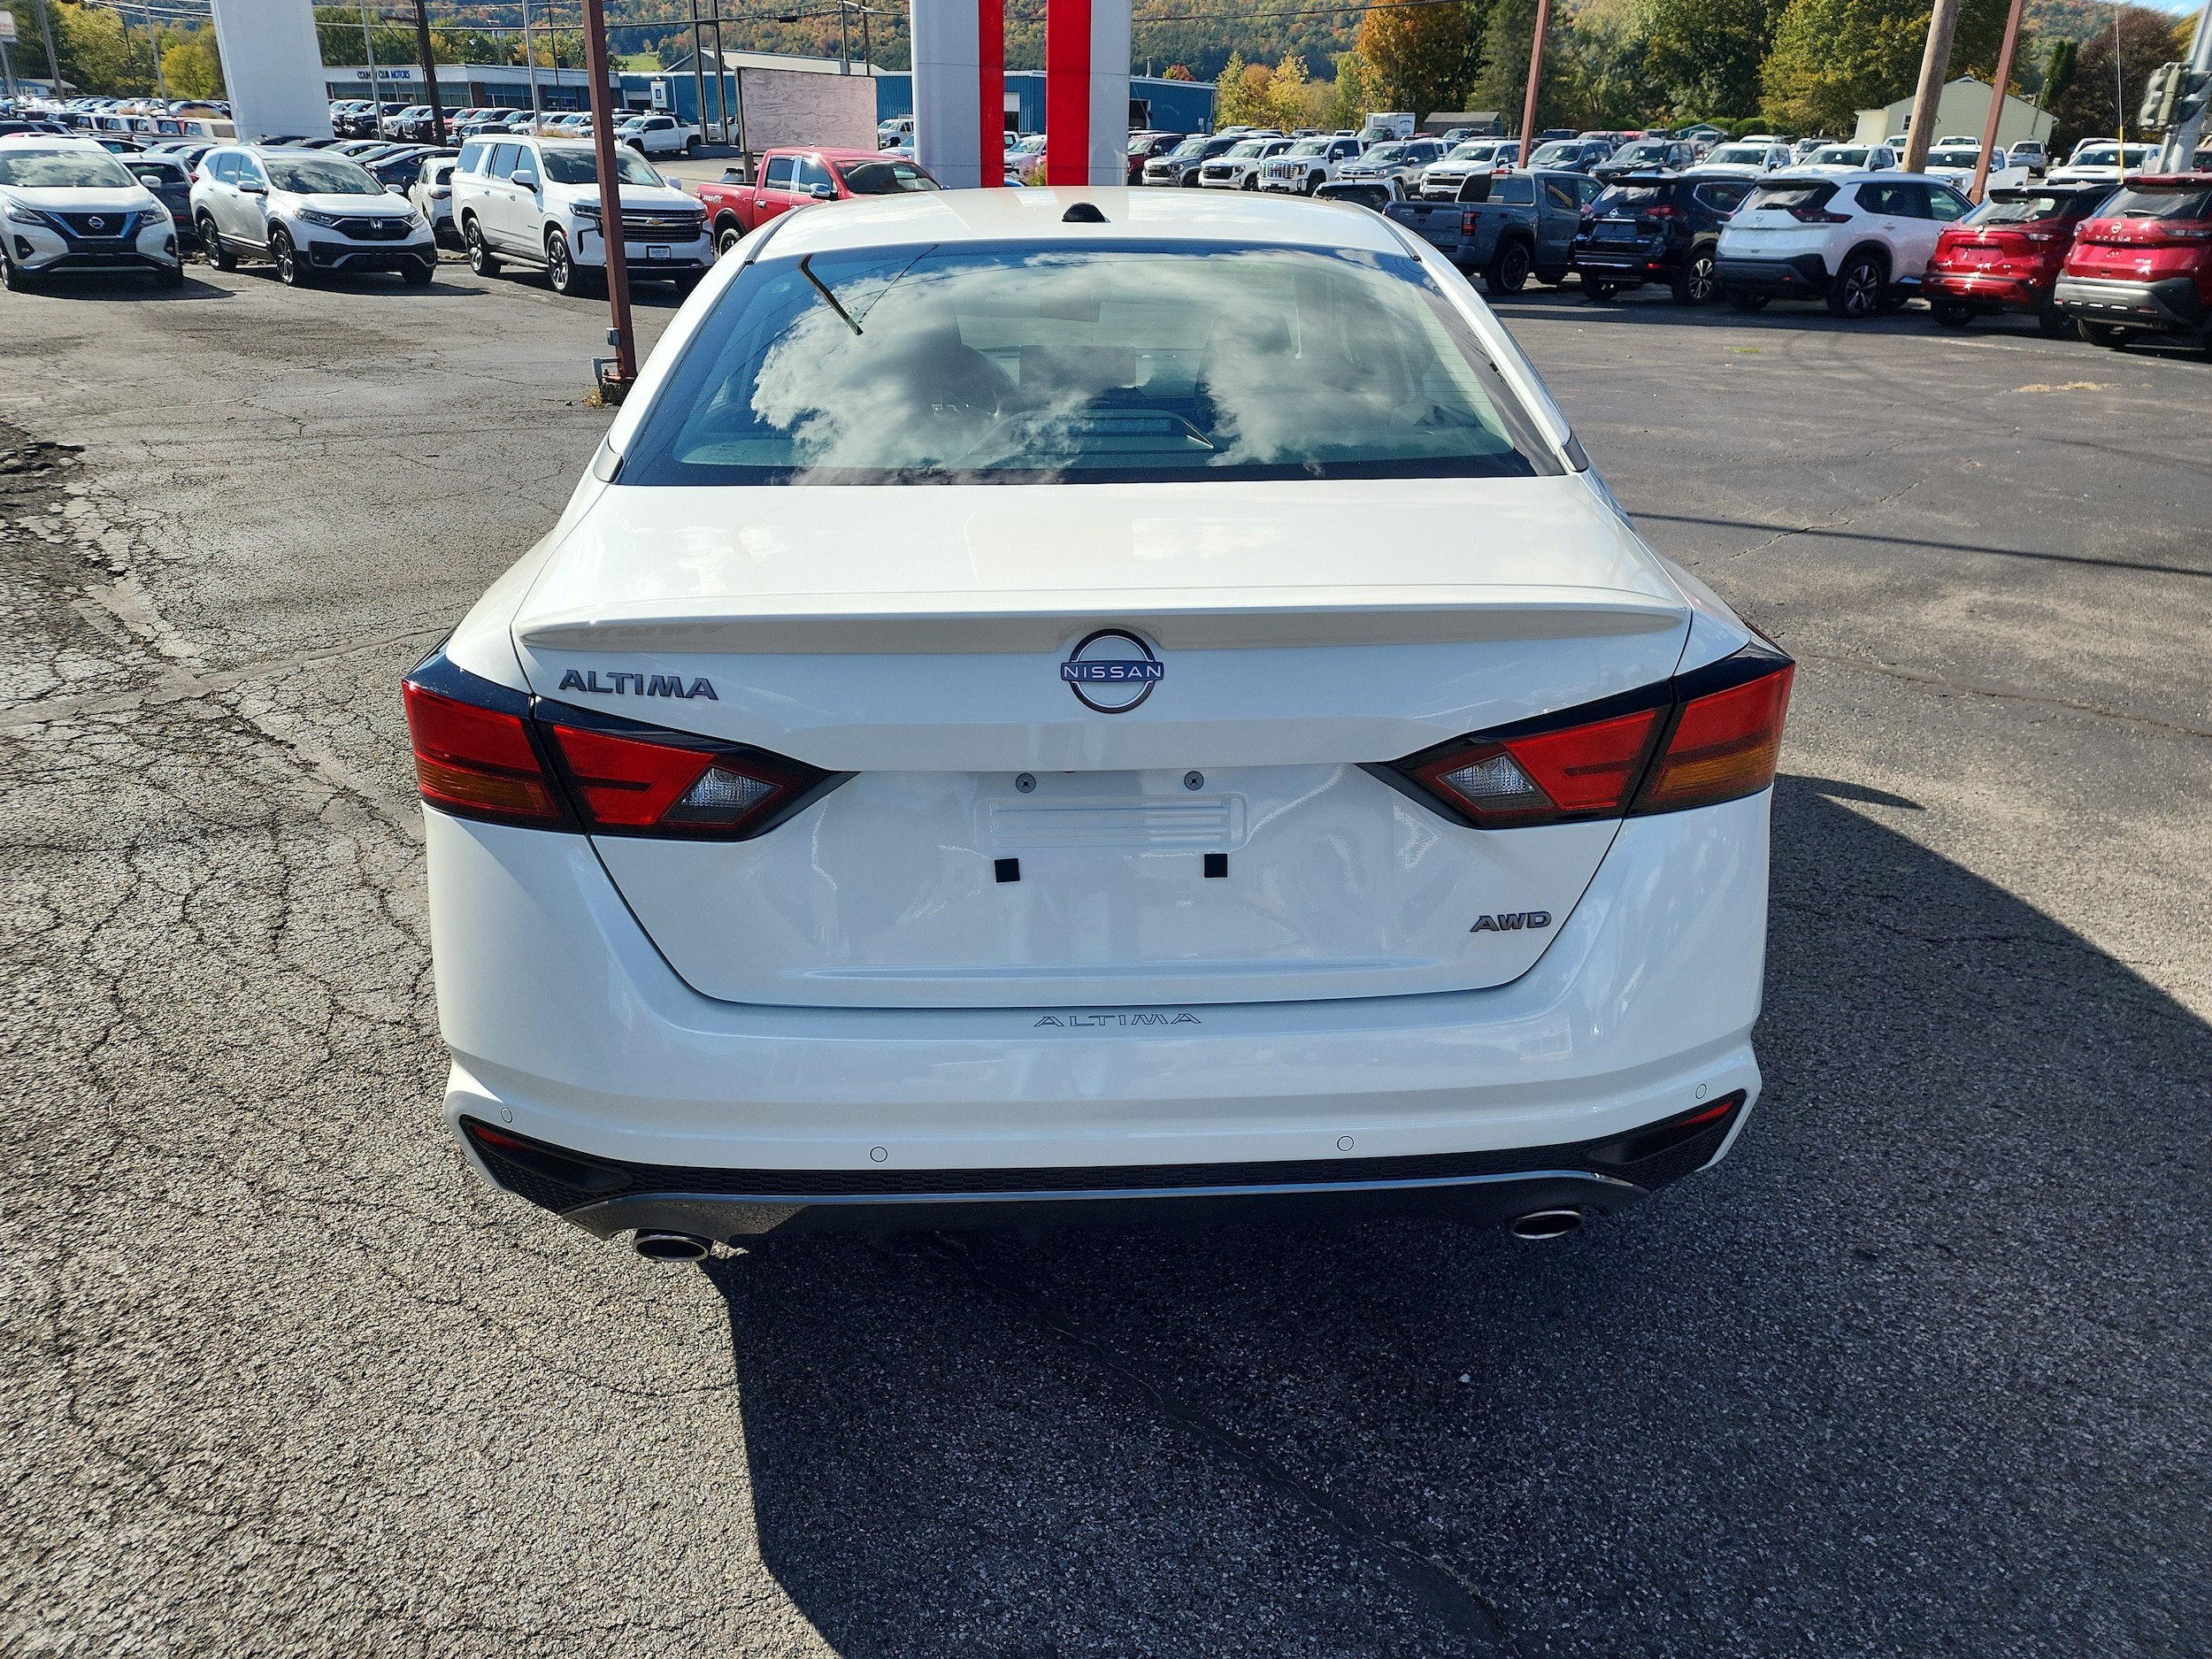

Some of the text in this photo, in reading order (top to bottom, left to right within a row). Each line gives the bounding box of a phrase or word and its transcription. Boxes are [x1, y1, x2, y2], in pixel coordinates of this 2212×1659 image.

[357, 71, 378, 80] COUN
[390, 70, 411, 80] MOTORS
[1064, 664, 1161, 679] NISSAN
[557, 669, 719, 701] ALTIMA
[1469, 910, 1552, 933] AWD
[1033, 1012, 1202, 1027] ALTIMA
